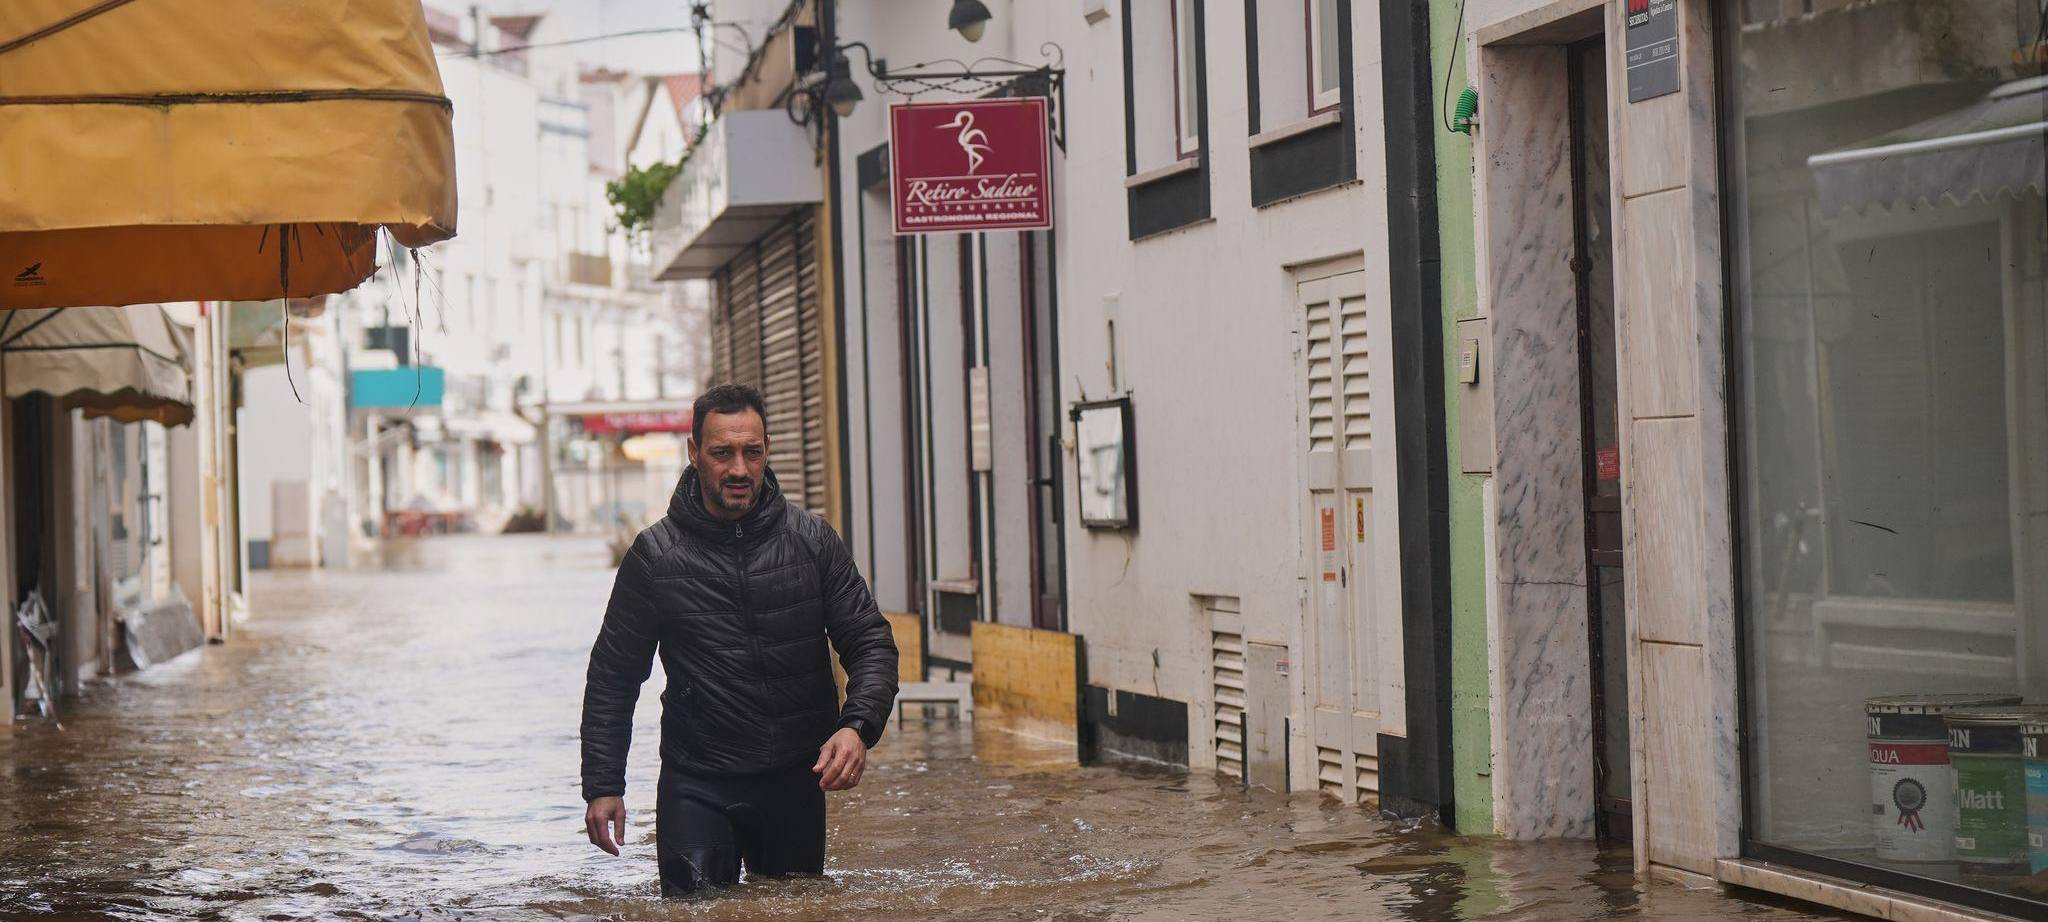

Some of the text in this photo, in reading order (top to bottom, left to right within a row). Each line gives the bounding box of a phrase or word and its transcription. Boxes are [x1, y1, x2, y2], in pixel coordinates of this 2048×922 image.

[906, 173, 1038, 206] Retiro Sadino
[906, 202, 1039, 213] RESTAURANTE
[906, 212, 1039, 224] GASTRONOMIA REGIONAL
[1871, 749, 1901, 763] QUA
[1960, 789, 2005, 810] Matt
